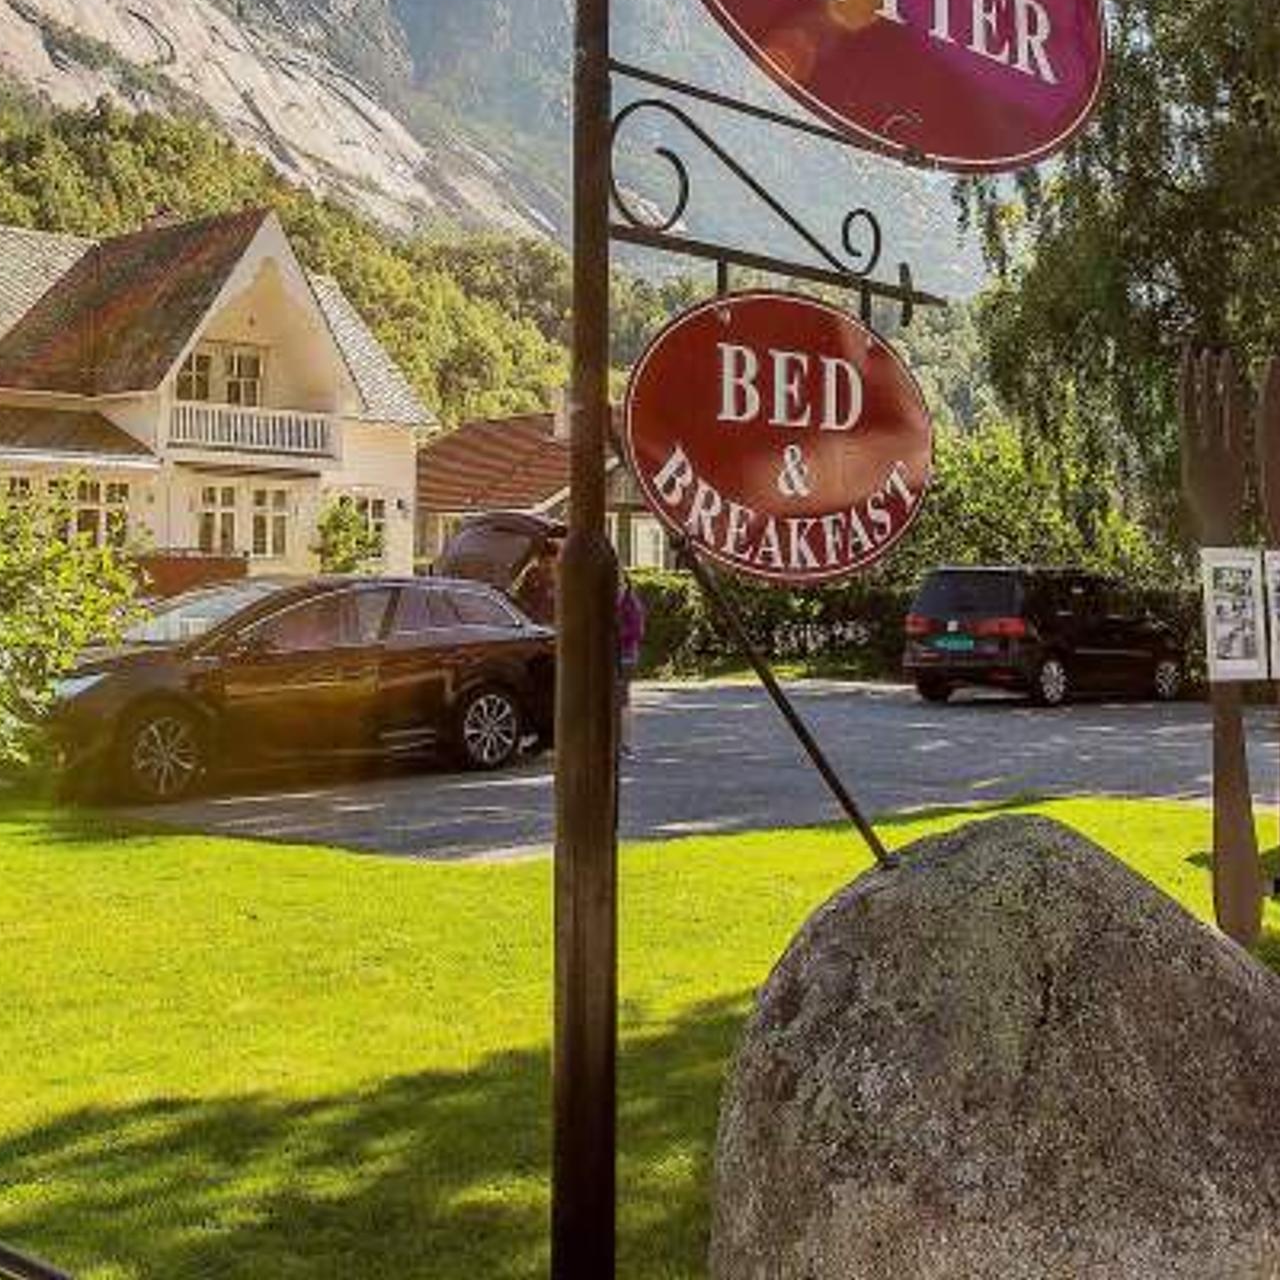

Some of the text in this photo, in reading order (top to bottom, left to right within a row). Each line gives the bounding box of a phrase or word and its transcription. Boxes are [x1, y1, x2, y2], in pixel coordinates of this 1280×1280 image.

[717, 342, 864, 431] BED
[653, 440, 916, 569] BREAKFAST
[777, 444, 810, 497] &
